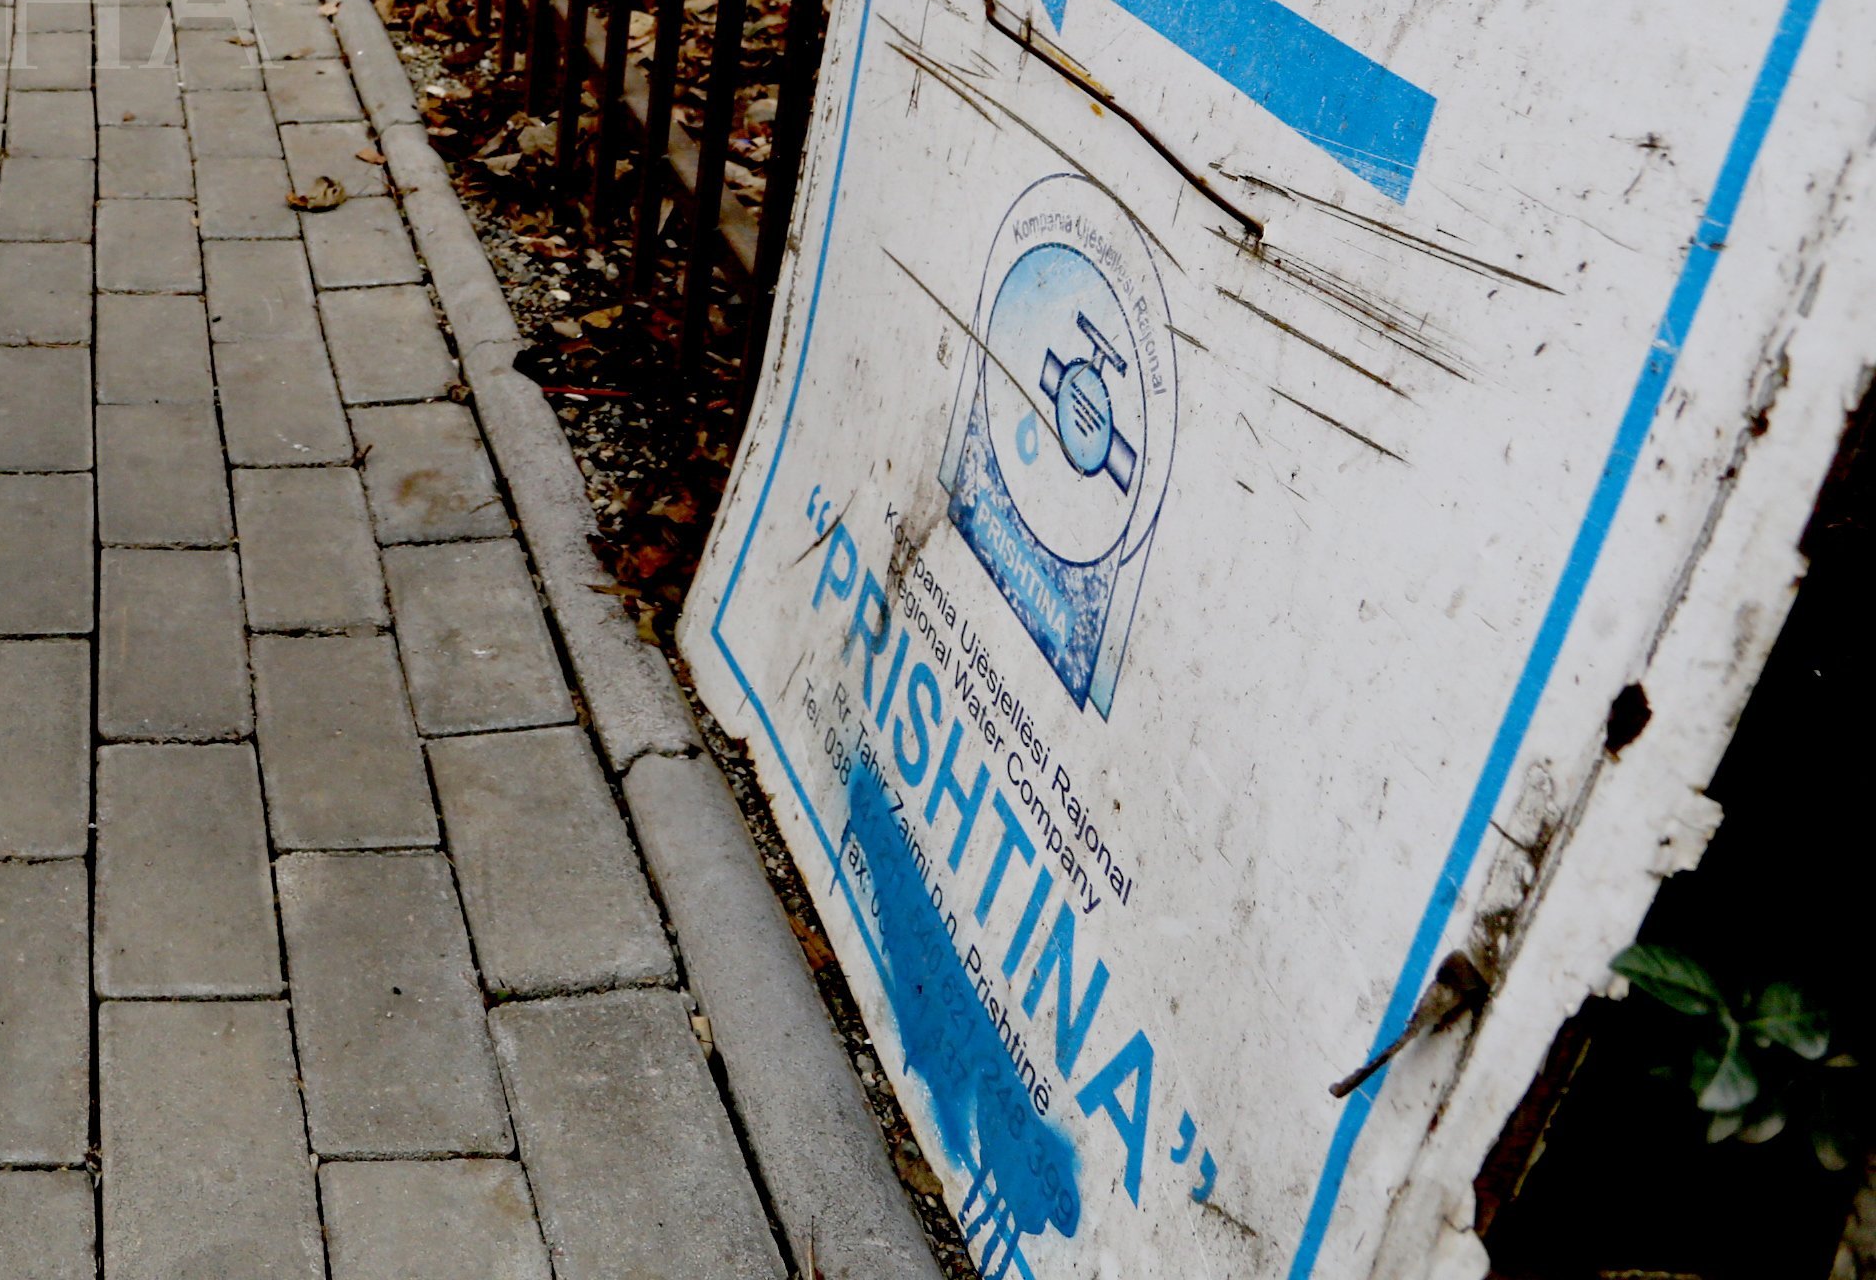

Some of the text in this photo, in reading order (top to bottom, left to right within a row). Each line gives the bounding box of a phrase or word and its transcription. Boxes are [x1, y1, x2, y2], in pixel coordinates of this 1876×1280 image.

[977, 500, 1067, 645] PRISHTINA
[824, 726, 852, 786] 038
[832, 680, 852, 733] Rr.
[960, 620, 1051, 774] Ujësjellësi
[1051, 764, 1133, 907] Rajonal
[954, 659, 1005, 754] Water
[1007, 751, 1102, 915] Company
